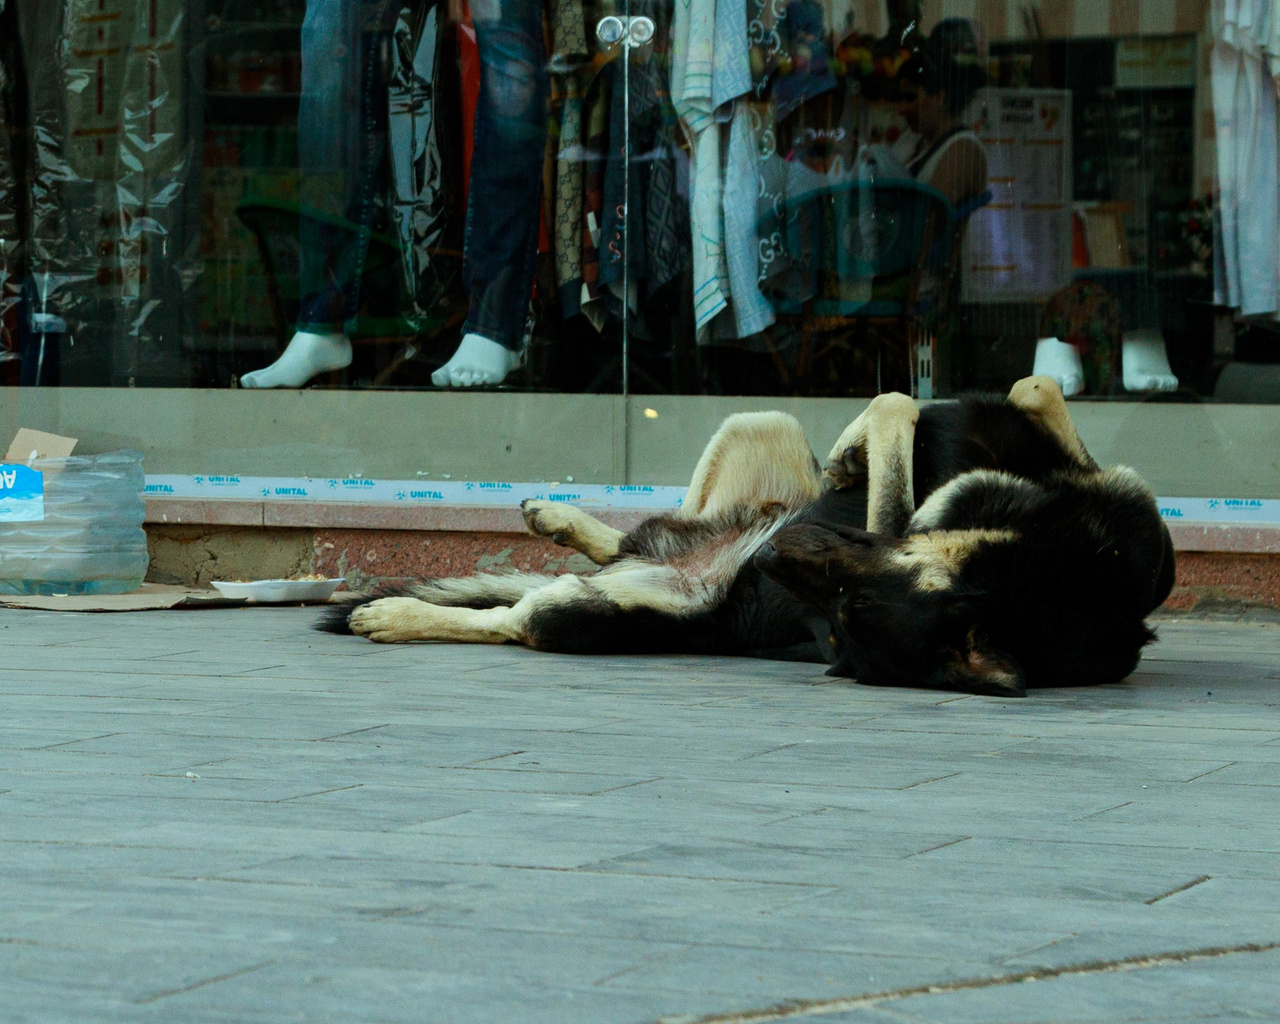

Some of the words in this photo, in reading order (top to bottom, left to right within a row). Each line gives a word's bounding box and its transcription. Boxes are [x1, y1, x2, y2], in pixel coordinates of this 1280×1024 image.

[274, 487, 308, 496] UNITAL
[410, 490, 444, 499] UNITAL
[1160, 508, 1184, 518] ITAL
